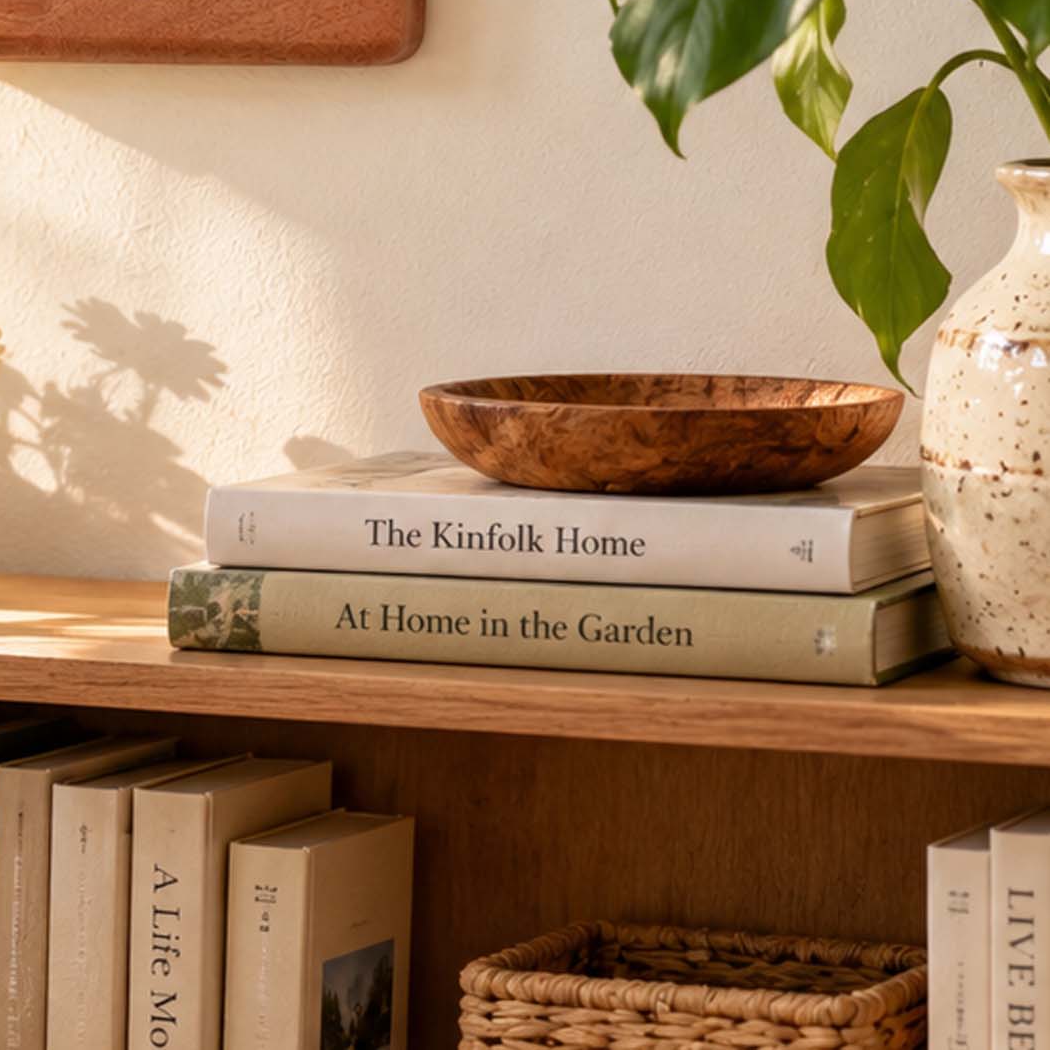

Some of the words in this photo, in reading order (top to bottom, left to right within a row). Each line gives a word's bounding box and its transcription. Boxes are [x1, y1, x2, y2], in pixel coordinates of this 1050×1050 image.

[365, 518, 422, 548] The
[432, 521, 544, 553] Kinfolk
[555, 526, 646, 556] Home
[335, 603, 371, 631] At
[380, 604, 471, 636] Home
[480, 608, 509, 638] in
[519, 610, 569, 641] the
[577, 613, 694, 647] Garden
[153, 863, 179, 893] A
[151, 904, 181, 977] Life
[1007, 887, 1035, 987] LIVE
[149, 989, 178, 1049] Mo
